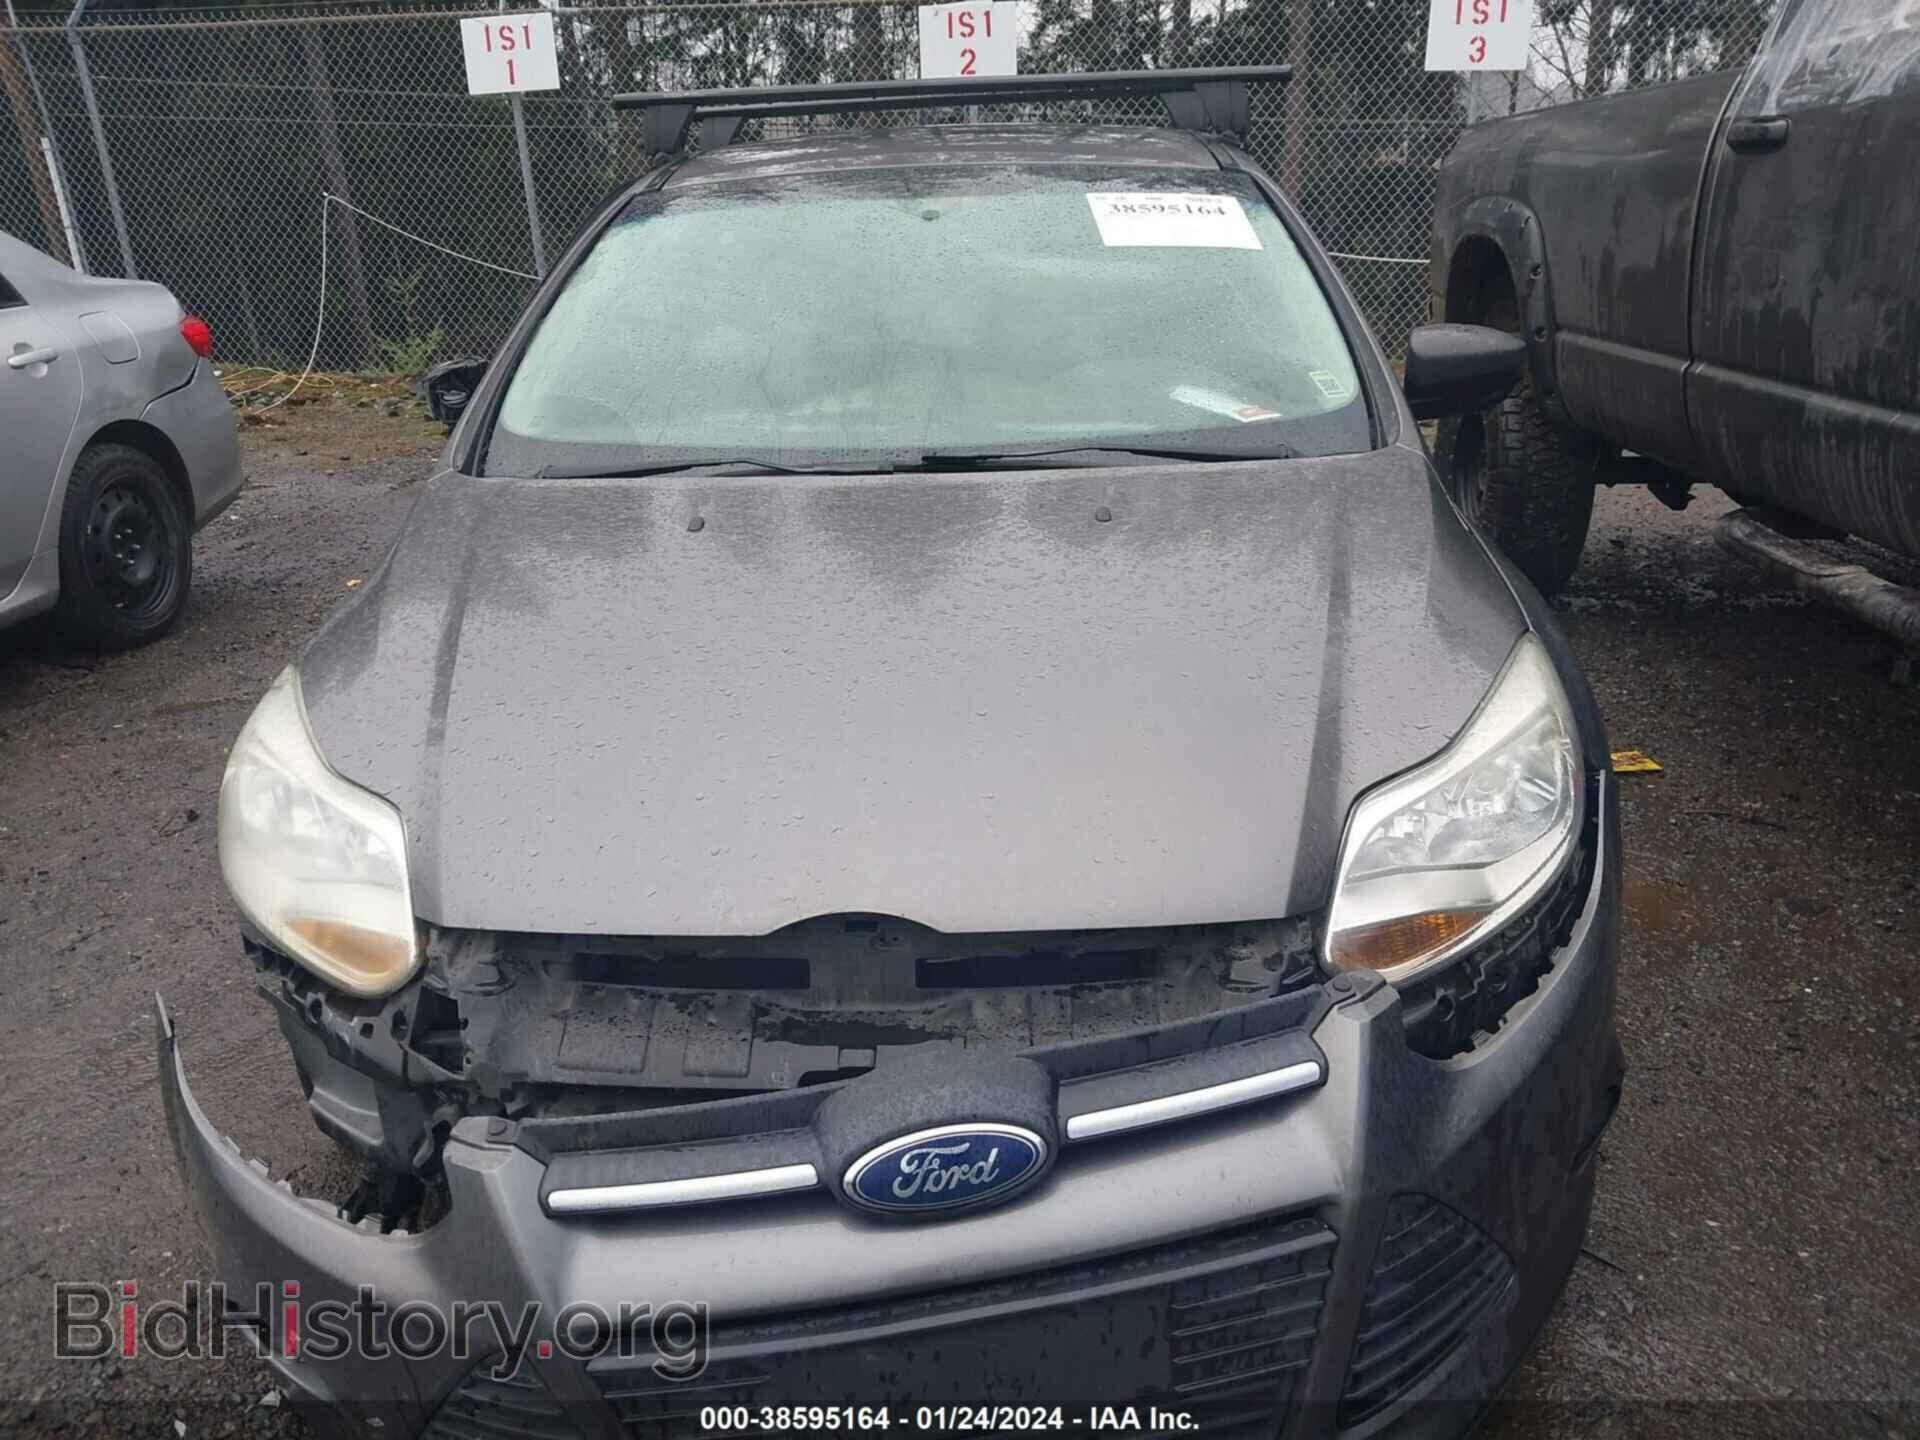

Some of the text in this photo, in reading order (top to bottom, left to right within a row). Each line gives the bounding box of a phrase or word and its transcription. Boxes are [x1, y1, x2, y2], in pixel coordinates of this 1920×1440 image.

[960, 48, 977, 75] 2
[1468, 36, 1487, 63] 3
[506, 58, 515, 86] 1
[892, 1142, 1000, 1198] Ford
